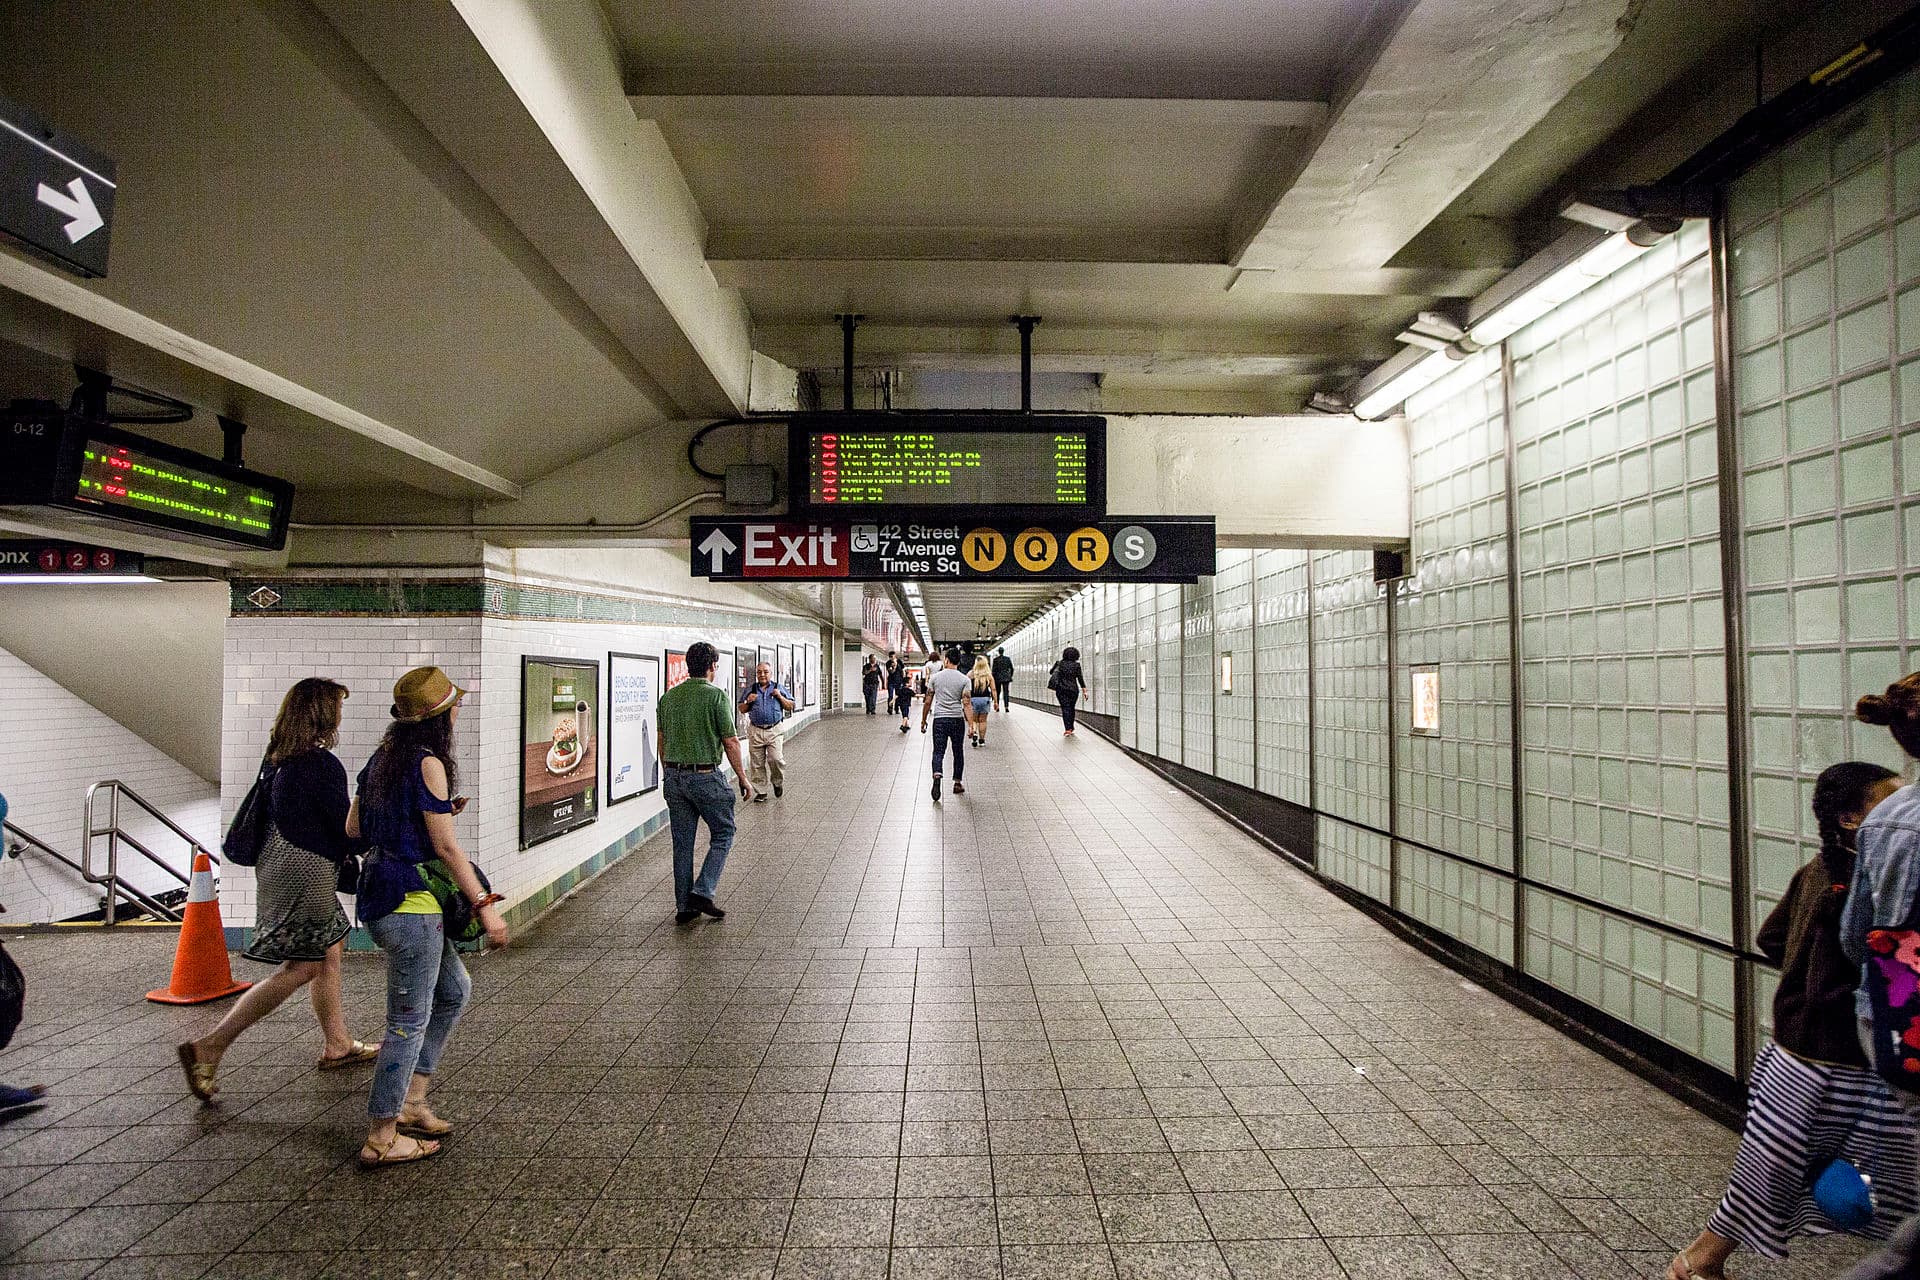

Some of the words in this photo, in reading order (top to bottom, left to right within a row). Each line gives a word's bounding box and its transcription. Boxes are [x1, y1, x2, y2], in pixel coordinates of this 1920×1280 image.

[879, 524, 901, 540] 42
[908, 524, 960, 540] Street
[744, 525, 838, 567] Exit
[879, 541, 890, 556] 7
[896, 541, 957, 556] Avenue
[974, 537, 994, 562] N
[1024, 535, 1047, 562] Q
[1077, 537, 1097, 562] R
[1124, 535, 1145, 561] S
[73, 553, 83, 566] 2
[99, 553, 110, 566] 3
[879, 557, 930, 573] Times
[936, 557, 960, 575] Sq
